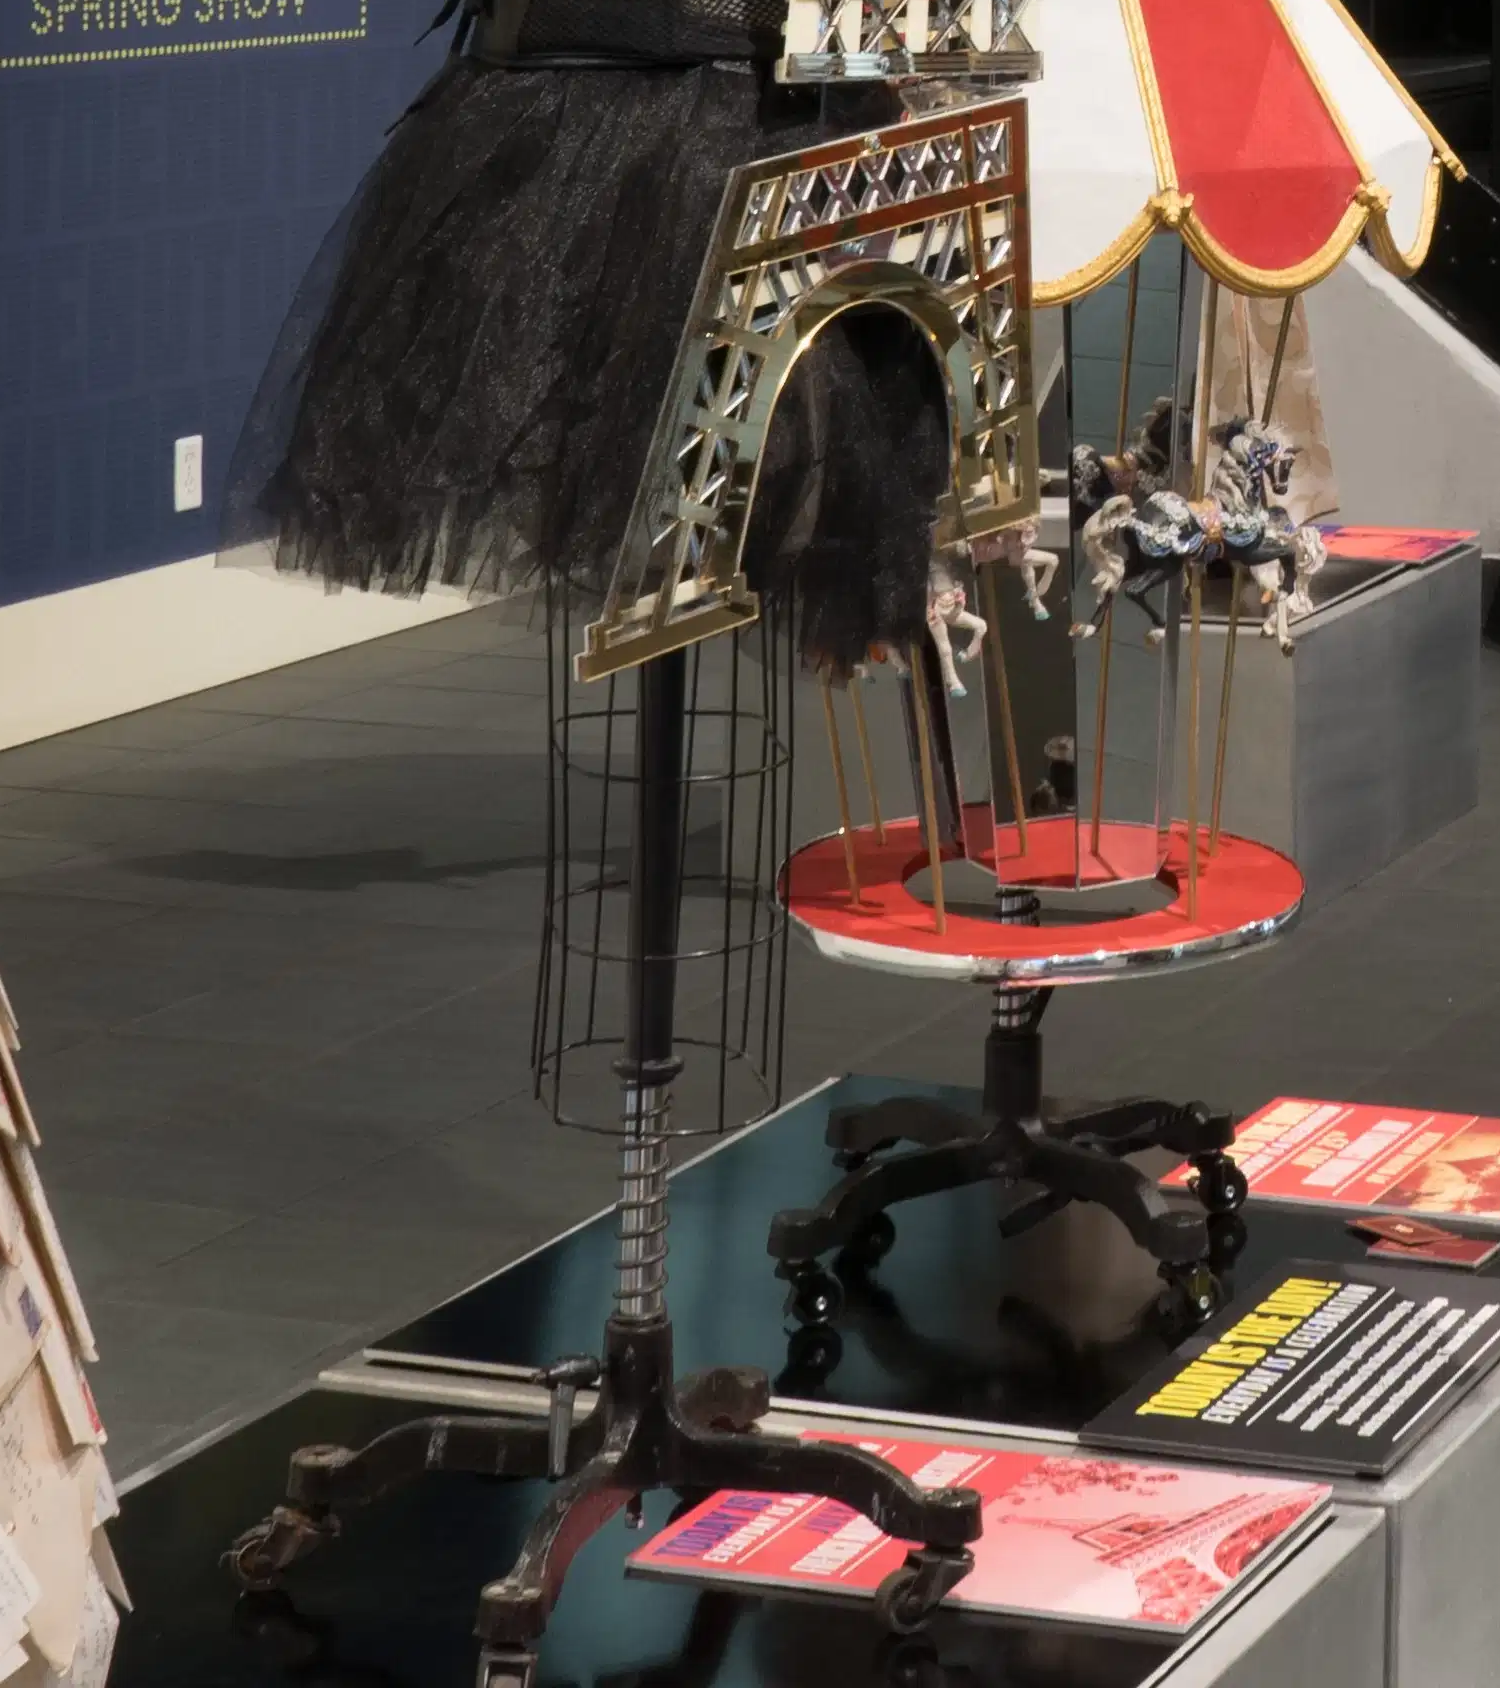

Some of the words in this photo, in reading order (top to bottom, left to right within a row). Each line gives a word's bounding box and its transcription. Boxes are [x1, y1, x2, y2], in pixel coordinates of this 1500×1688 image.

[1250, 1276, 1345, 1317] DAY!
[1215, 1312, 1305, 1347] THE
[1195, 1341, 1272, 1366] IS
[1131, 1360, 1250, 1421] TODAY
[1197, 1367, 1287, 1424] EVERYDAY
[652, 1510, 751, 1559] TODAY
